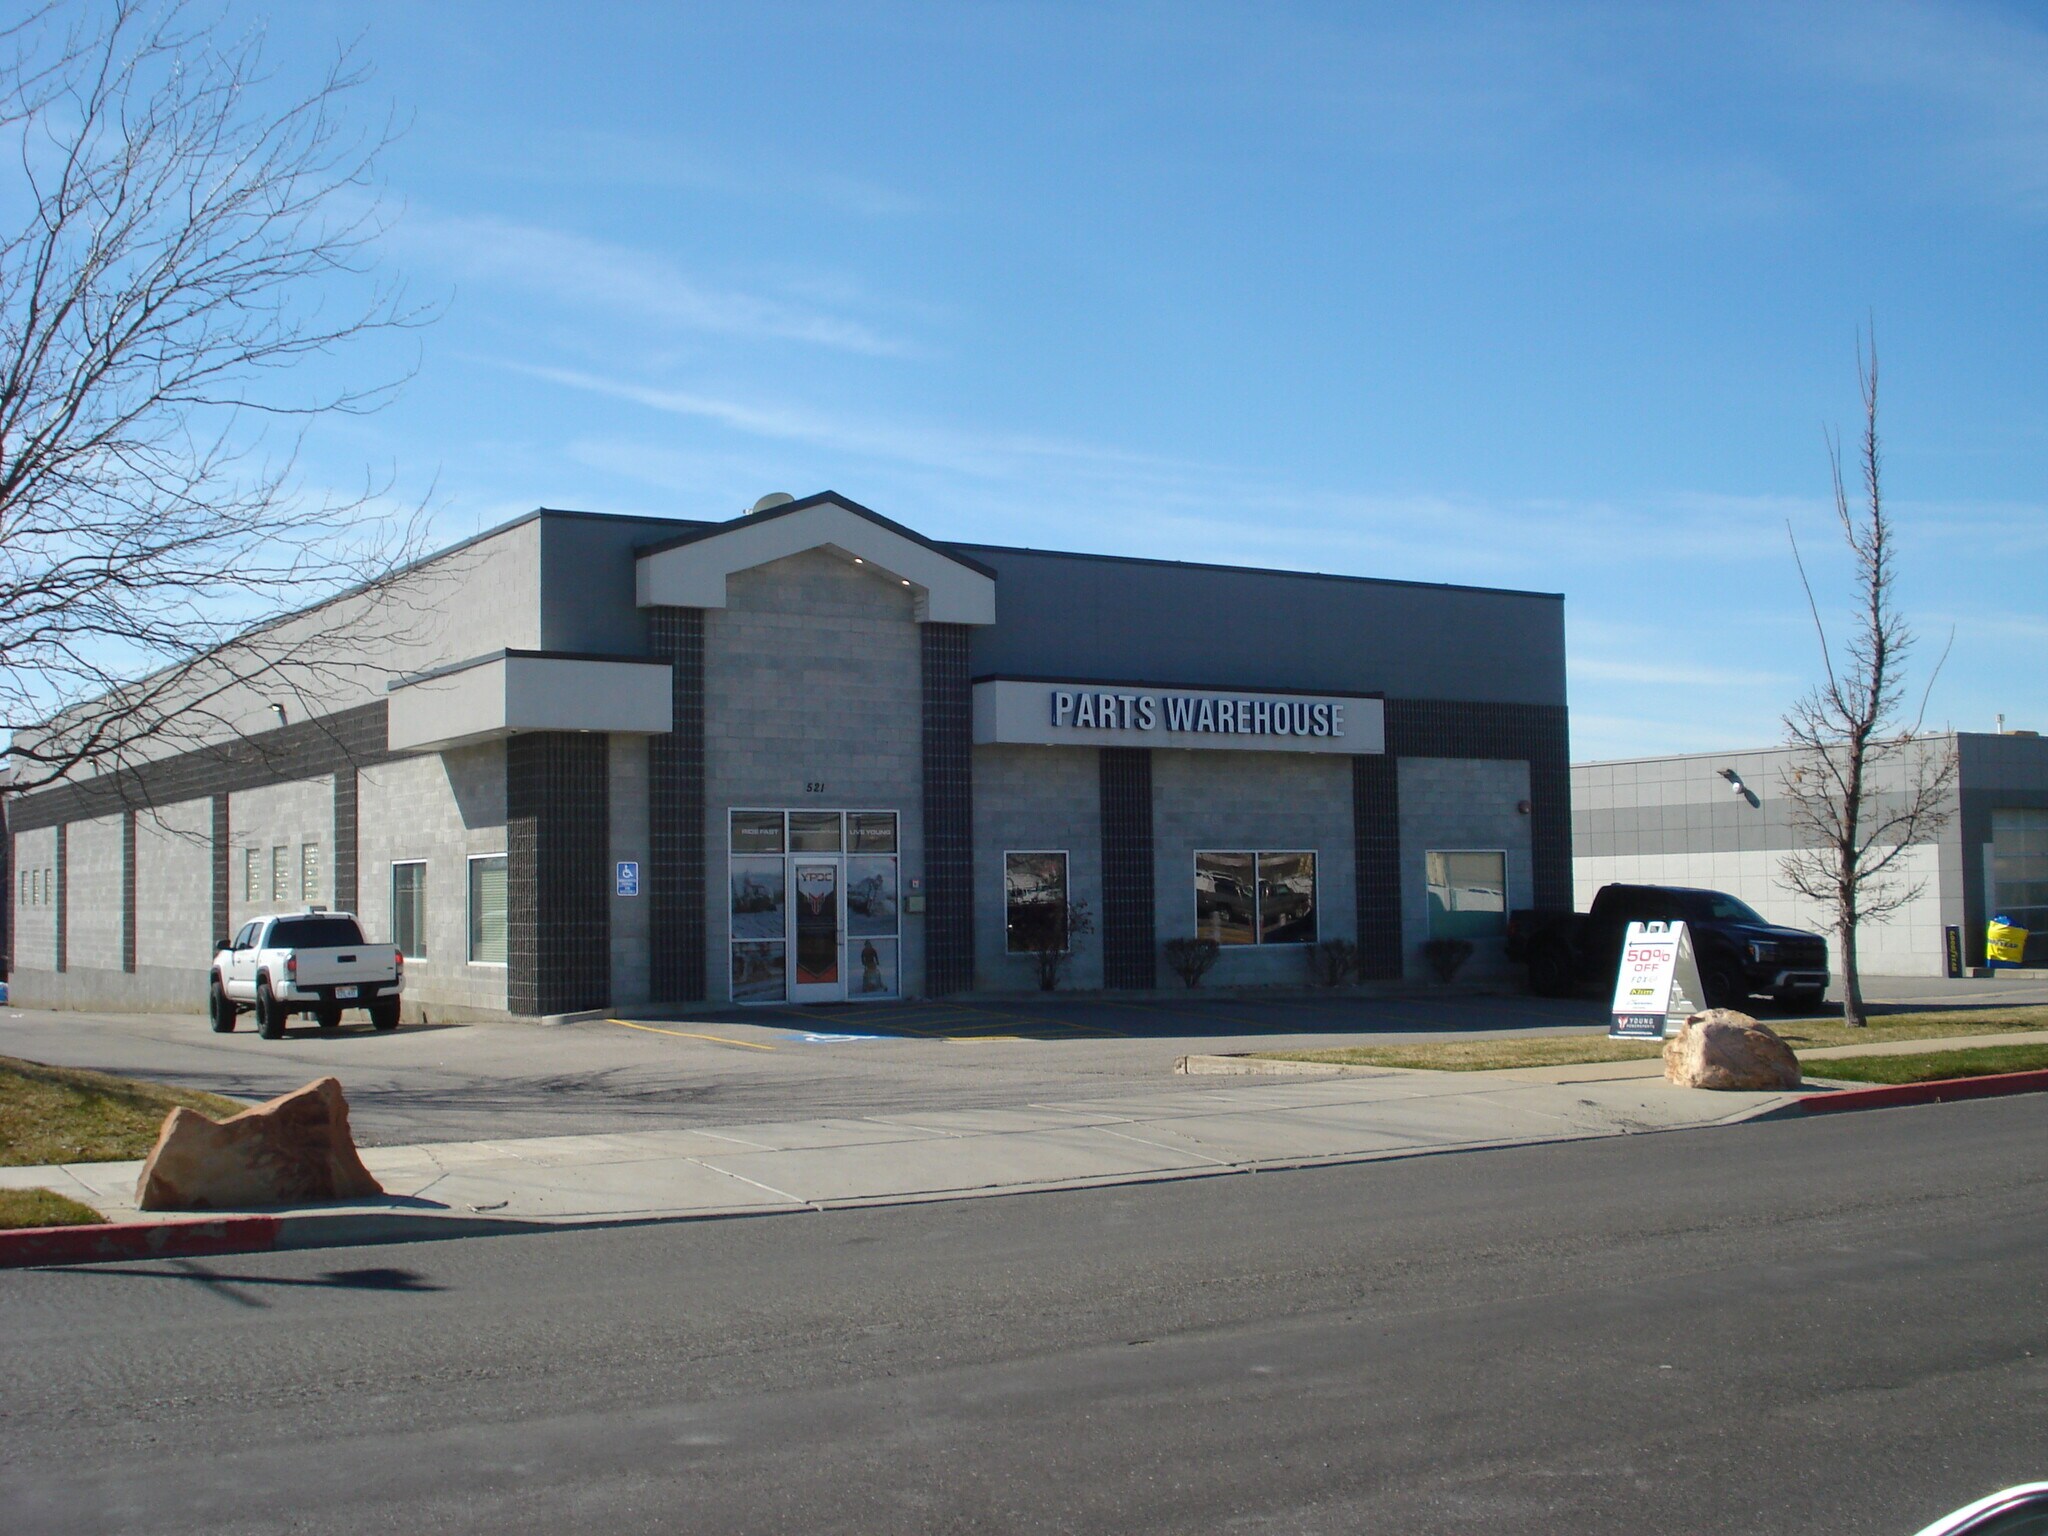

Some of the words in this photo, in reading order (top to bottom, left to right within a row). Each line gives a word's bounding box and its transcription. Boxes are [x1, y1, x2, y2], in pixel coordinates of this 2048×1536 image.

[1052, 691, 1156, 730] PARTS
[1164, 697, 1345, 737] WAREHOUSE
[806, 783, 825, 793] 521
[741, 828, 759, 836] RIDE
[760, 828, 779, 836] FAST
[1627, 949, 1670, 962] 50%
[1634, 964, 1659, 972] OFF
